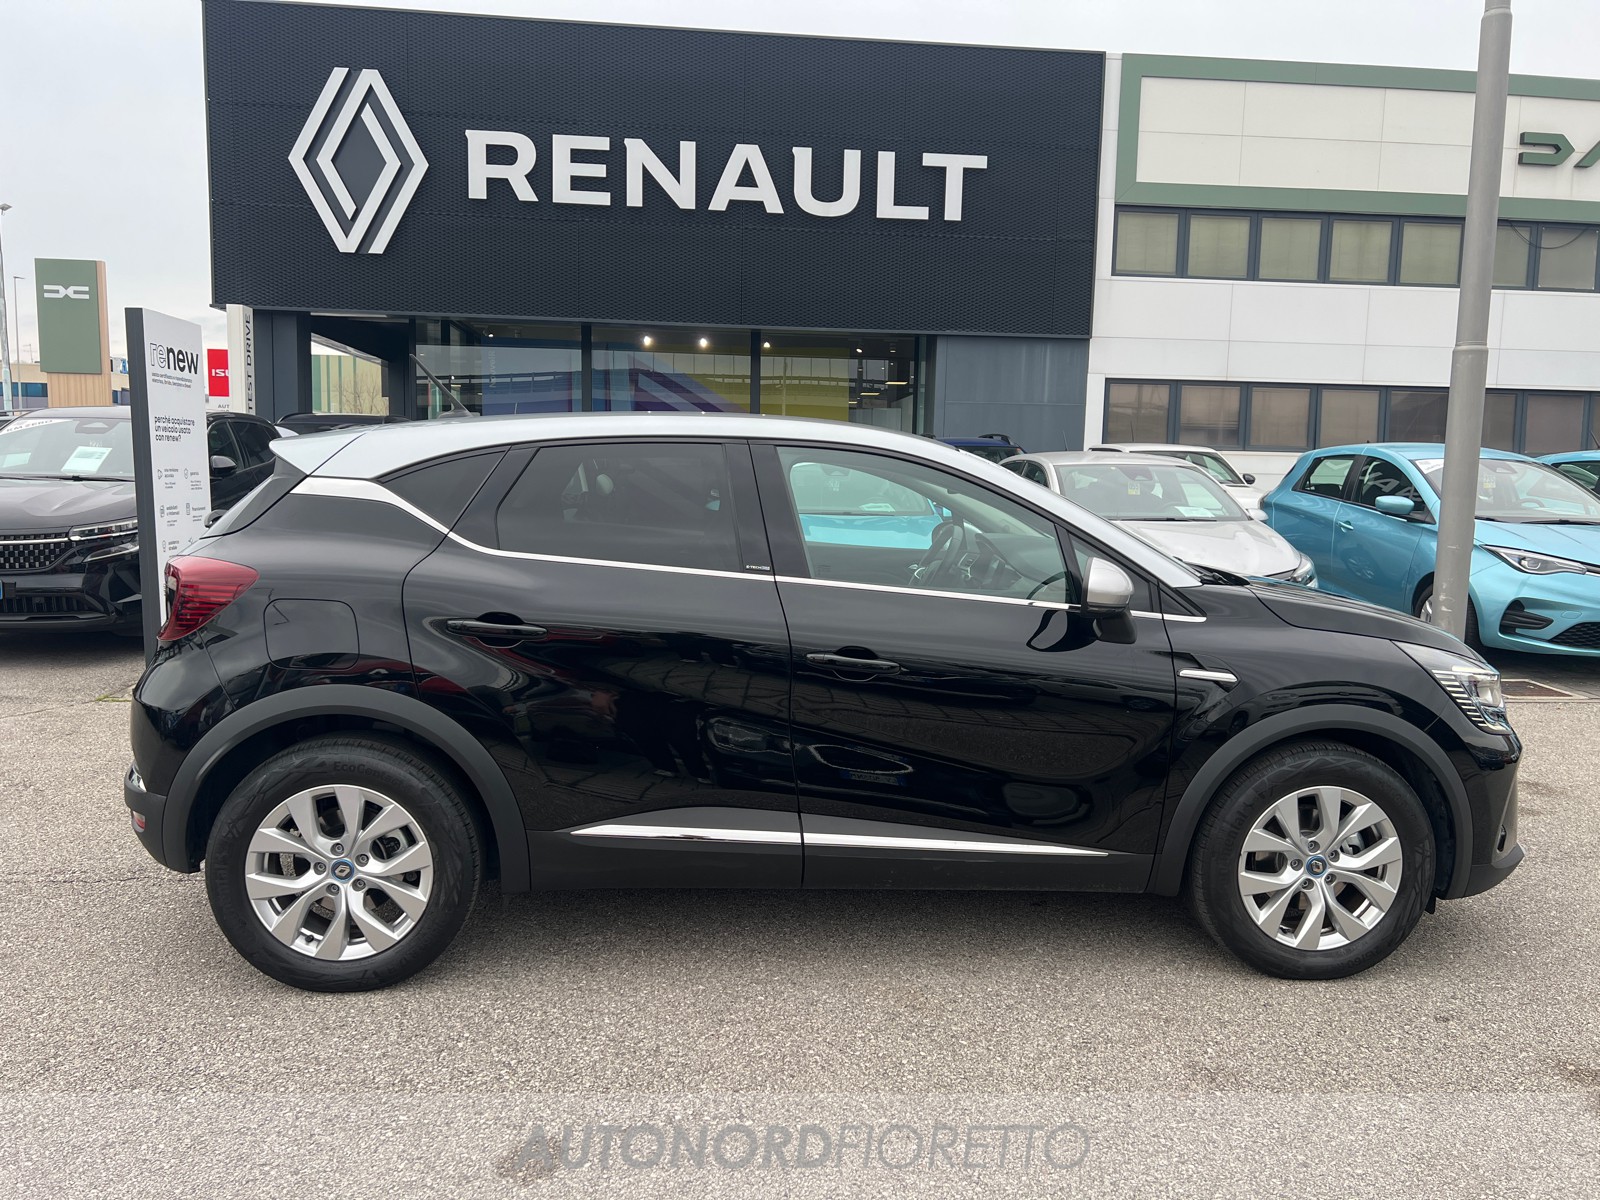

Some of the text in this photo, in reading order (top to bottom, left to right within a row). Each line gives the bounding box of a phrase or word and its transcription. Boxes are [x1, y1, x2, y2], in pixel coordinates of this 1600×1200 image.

[464, 129, 988, 221] RENAULT
[150, 342, 199, 375] renew
[244, 313, 252, 366] DRIVE
